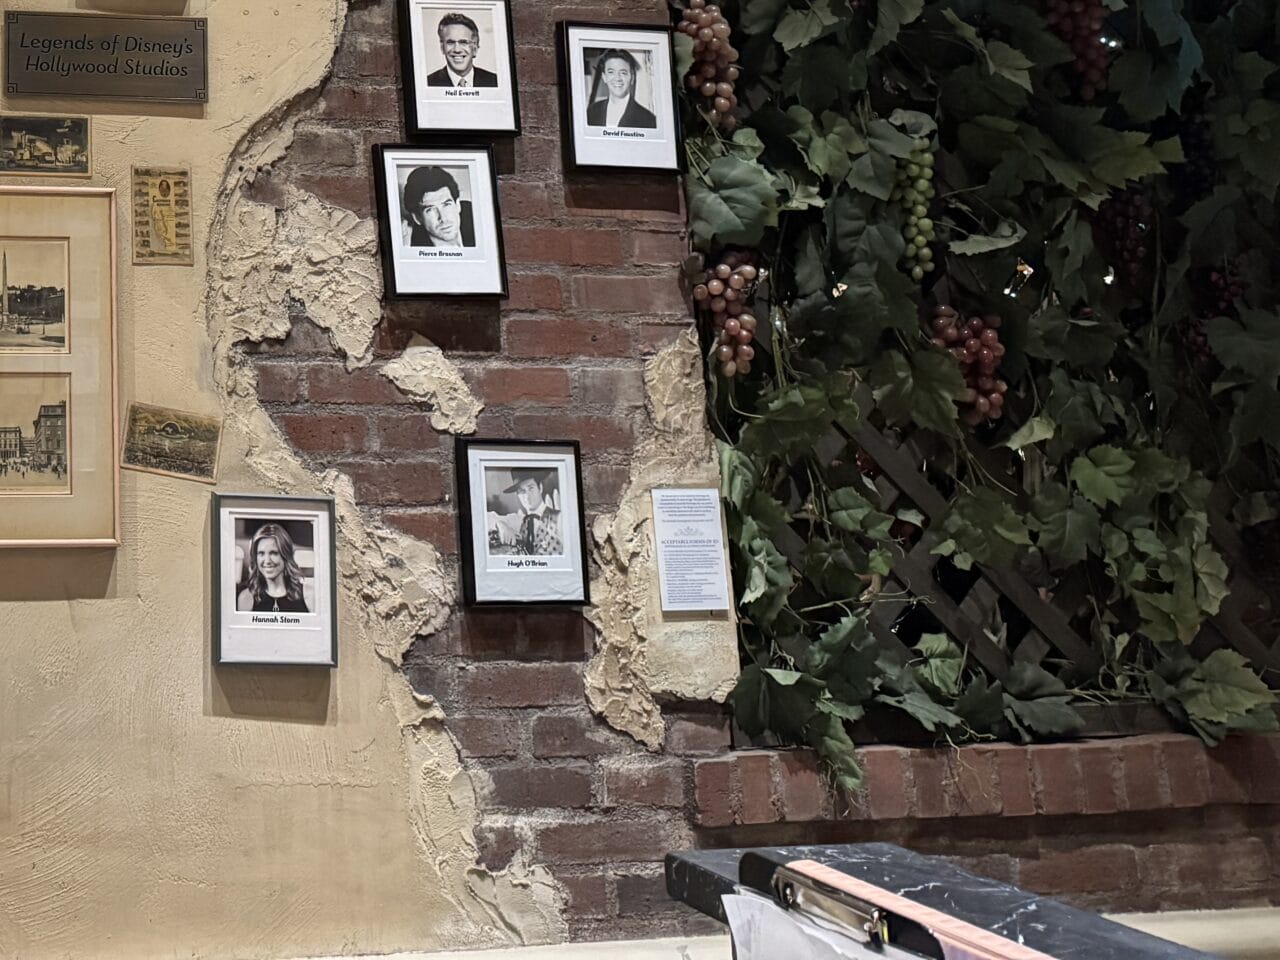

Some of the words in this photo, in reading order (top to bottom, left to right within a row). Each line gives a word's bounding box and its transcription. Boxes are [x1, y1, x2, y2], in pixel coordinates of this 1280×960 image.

[20, 33, 94, 53] Legends
[100, 35, 120, 55] of
[124, 36, 193, 58] Disney's
[25, 55, 119, 77] Hollywood
[123, 58, 188, 77] Studios
[508, 560, 525, 568] Hugh
[252, 616, 277, 624] Hannah
[279, 616, 300, 624] Storm
